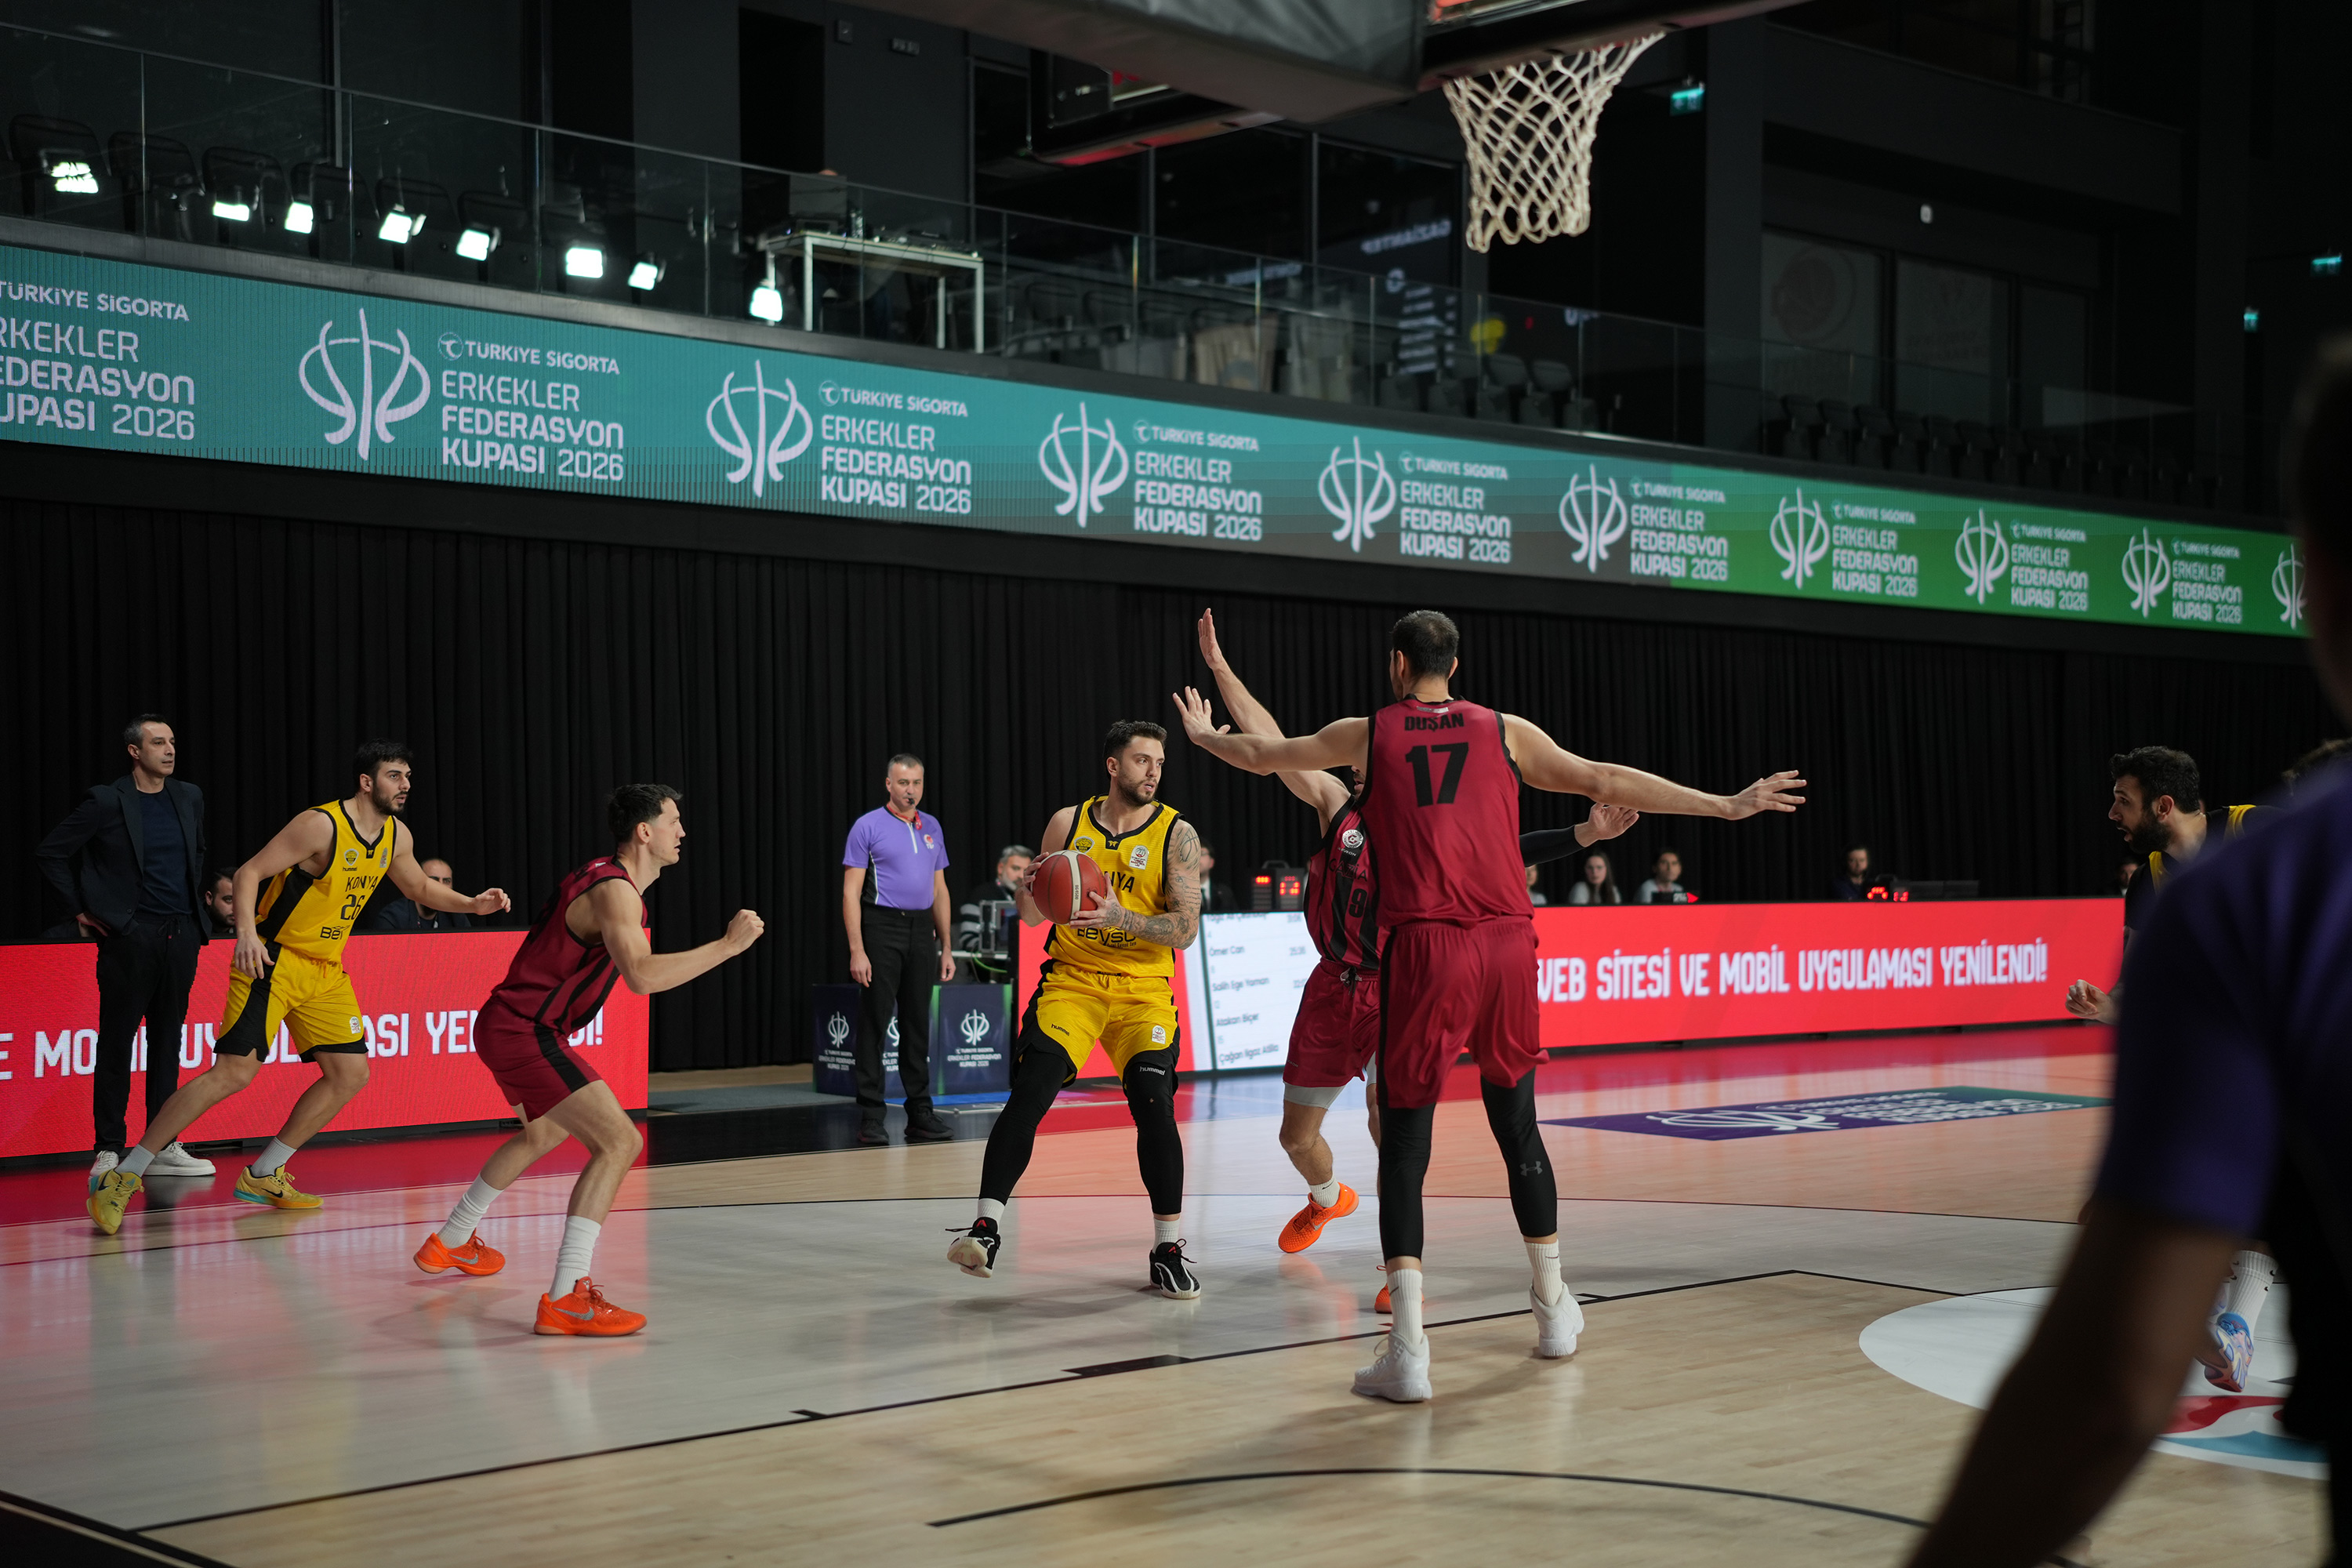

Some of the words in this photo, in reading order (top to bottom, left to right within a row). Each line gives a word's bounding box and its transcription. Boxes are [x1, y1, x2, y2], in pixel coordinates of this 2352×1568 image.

[97, 293, 189, 321] SİGORTA
[465, 340, 540, 365] TÜRKİYE
[546, 350, 620, 375] SİGORTA
[0, 355, 194, 405] DERASYON
[442, 370, 579, 412] ERKEKLER
[840, 387, 903, 408] TÜRKİYE
[907, 396, 968, 417] SİGORTA
[822, 415, 935, 452] ERKEKLER
[442, 437, 545, 474] KUPASI
[558, 449, 623, 481] 2026
[1135, 452, 1232, 484] ERKEKLER
[822, 475, 906, 508] KUPASI
[916, 485, 971, 514] 2026
[1401, 481, 1483, 510] ERKEKLER
[1134, 506, 1207, 536] KUPASI
[1214, 514, 1262, 541] 2026
[1631, 504, 1704, 532] ERKEKLER
[1400, 531, 1463, 559] KUPASI
[1468, 538, 1511, 564] 2026
[1832, 525, 1897, 550] ERKEKLER
[1631, 552, 1686, 577] KUPASI
[1691, 558, 1728, 581] 2026
[1832, 570, 1881, 594] KUPASI
[1885, 575, 1918, 597] 2026
[2011, 584, 2055, 608] KUPASI
[2058, 590, 2088, 612] 2026
[1404, 713, 1465, 732] DUŞAN
[1405, 742, 1469, 808] 17
[345, 876, 379, 892] KONYA
[1105, 871, 1135, 893] NYA
[340, 894, 365, 920] 26
[1348, 888, 1367, 918] 9
[320, 926, 343, 940] Be
[1230, 946, 1244, 954] Can
[1596, 947, 1671, 1000] SİTESİ
[1679, 953, 1711, 996] VE
[1719, 944, 1791, 996] MOBİL
[1798, 946, 1933, 992] UYGULAMASI
[1940, 937, 2048, 987] YENİLENDİ!
[1051, 1023, 1069, 1036] hummel
[1139, 1065, 1166, 1076] hummel
